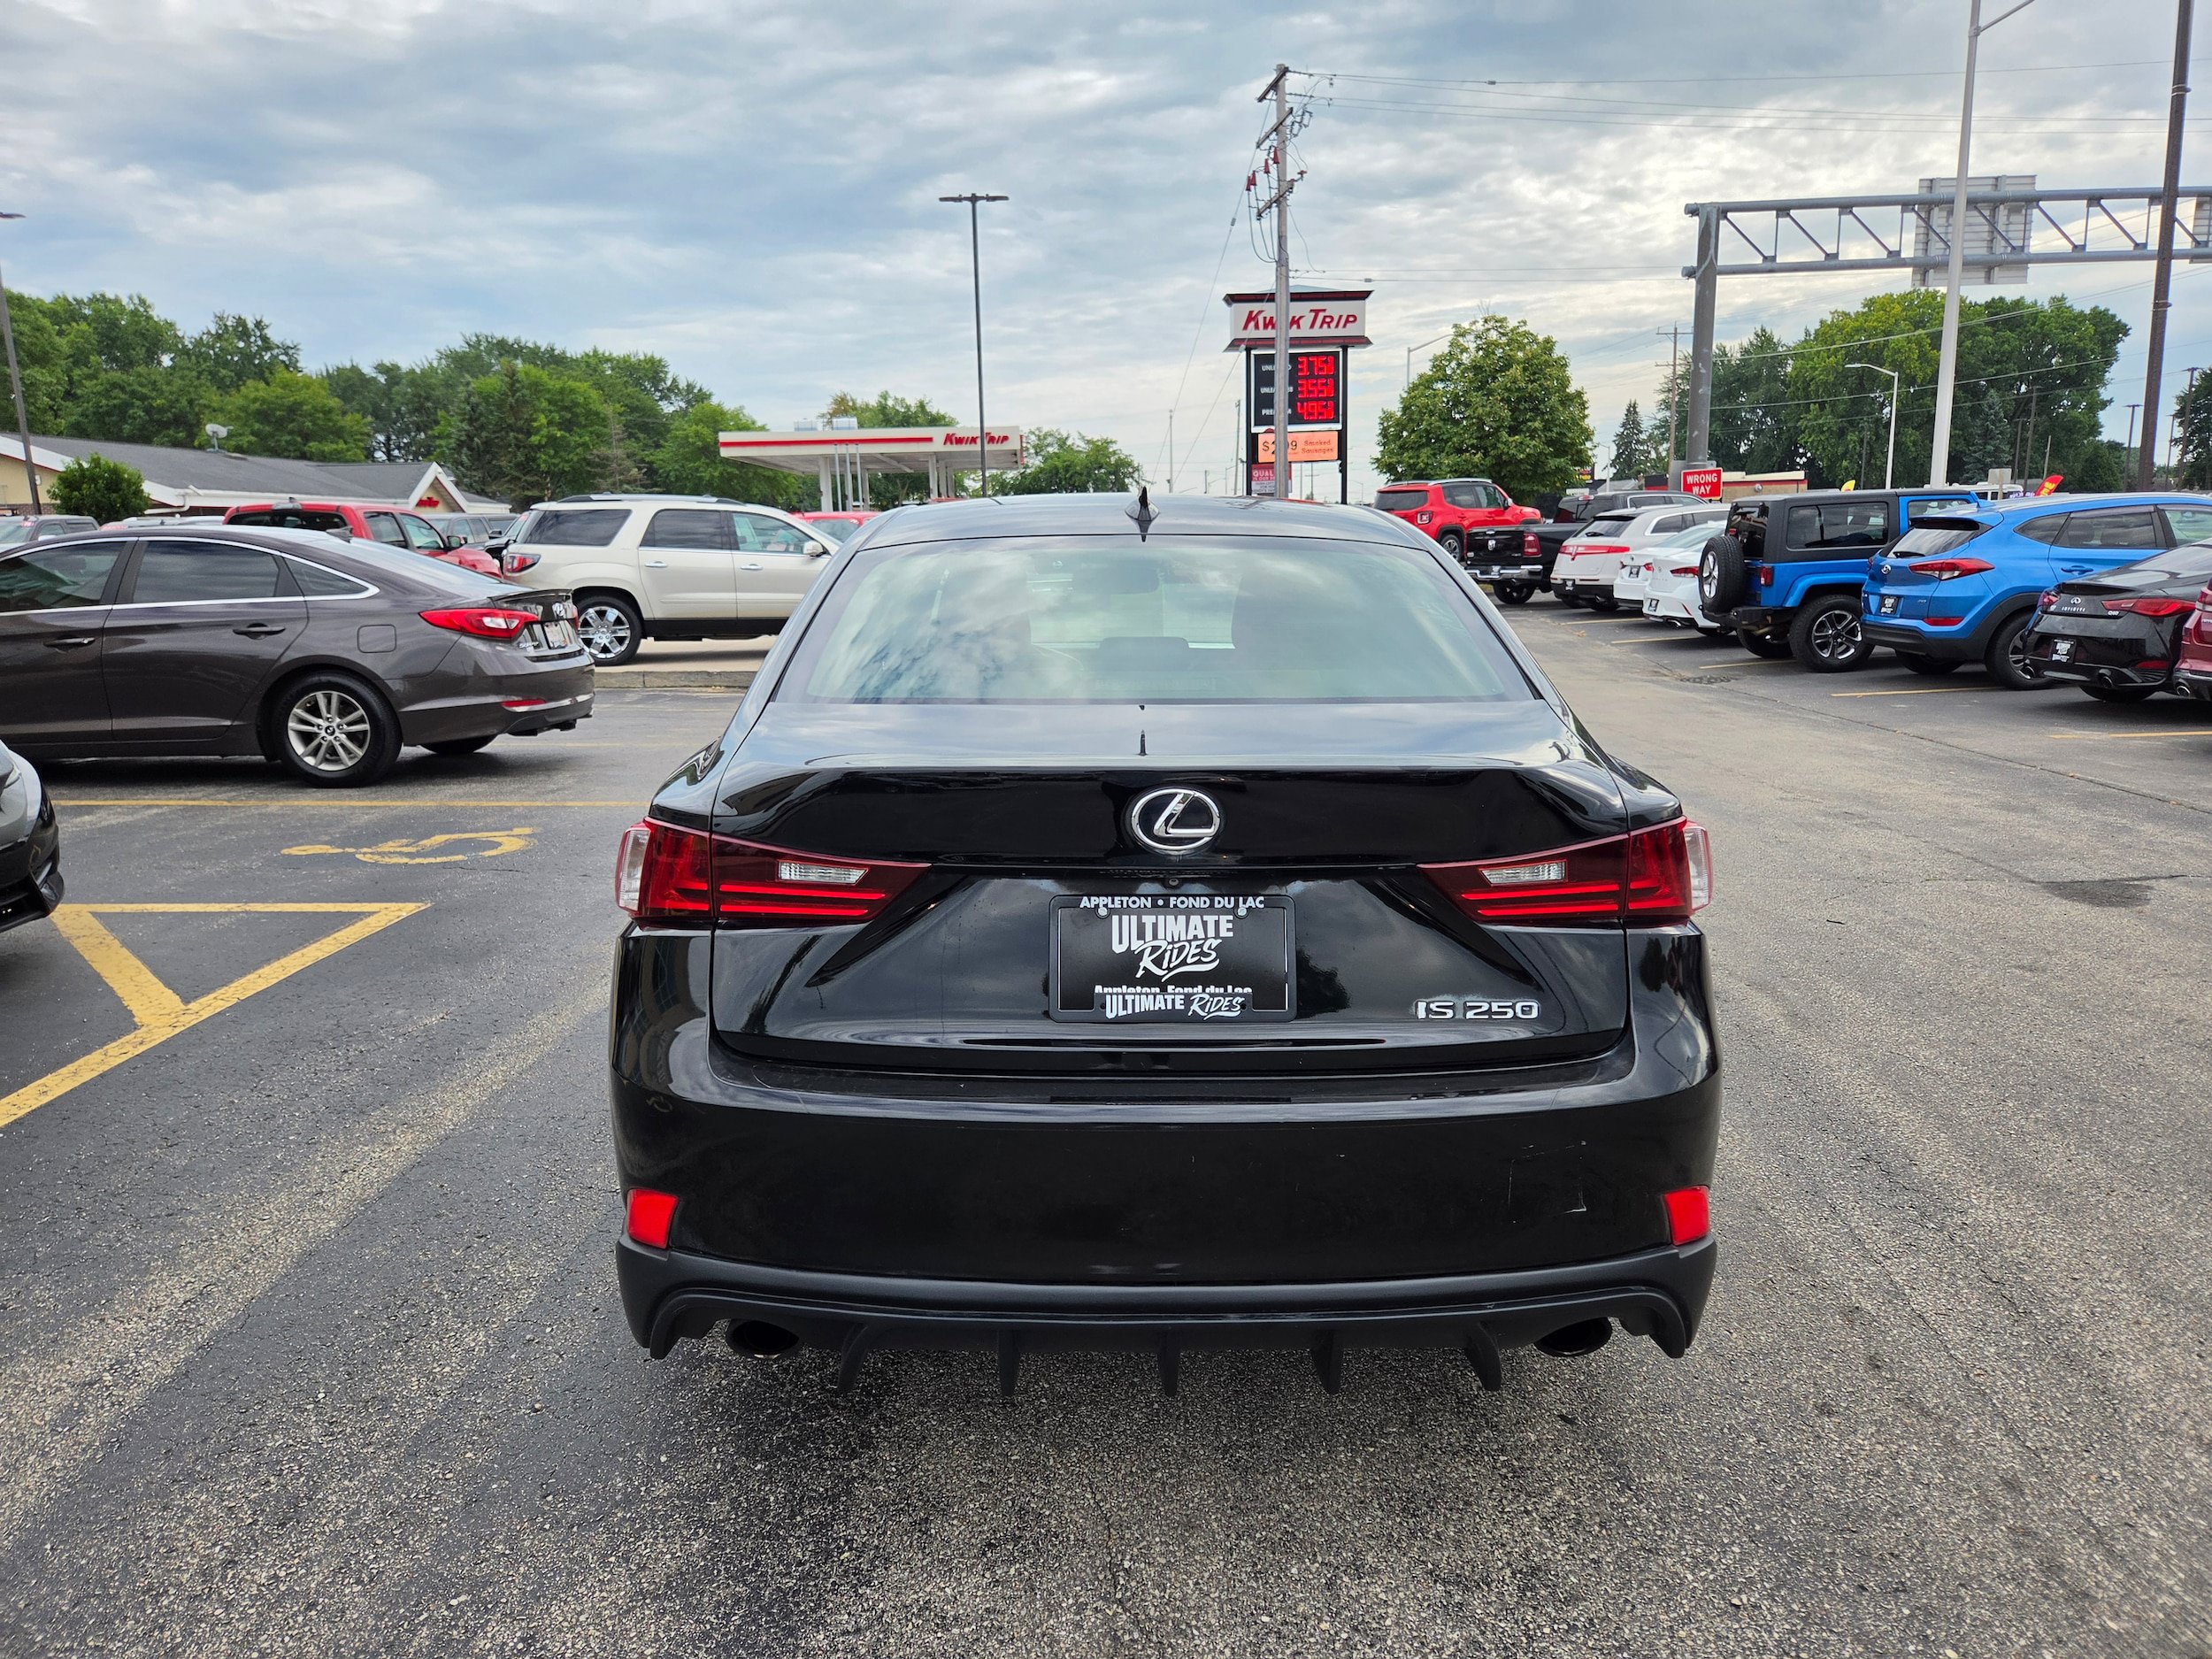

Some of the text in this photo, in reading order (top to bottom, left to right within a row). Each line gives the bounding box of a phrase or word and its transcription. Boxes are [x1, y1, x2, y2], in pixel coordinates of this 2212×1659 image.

[1242, 309, 1358, 331] KWK TRIP
[943, 433, 980, 445] KWIK
[1686, 473, 1717, 484] WRONG
[1692, 485, 1711, 495] WAY
[1079, 896, 1264, 909] APPLETON FOND DU LAC
[1111, 915, 1233, 954] ULTIMATE
[1105, 995, 1185, 1019] ULTIMATE
[1417, 1001, 1540, 1019] IS 250
